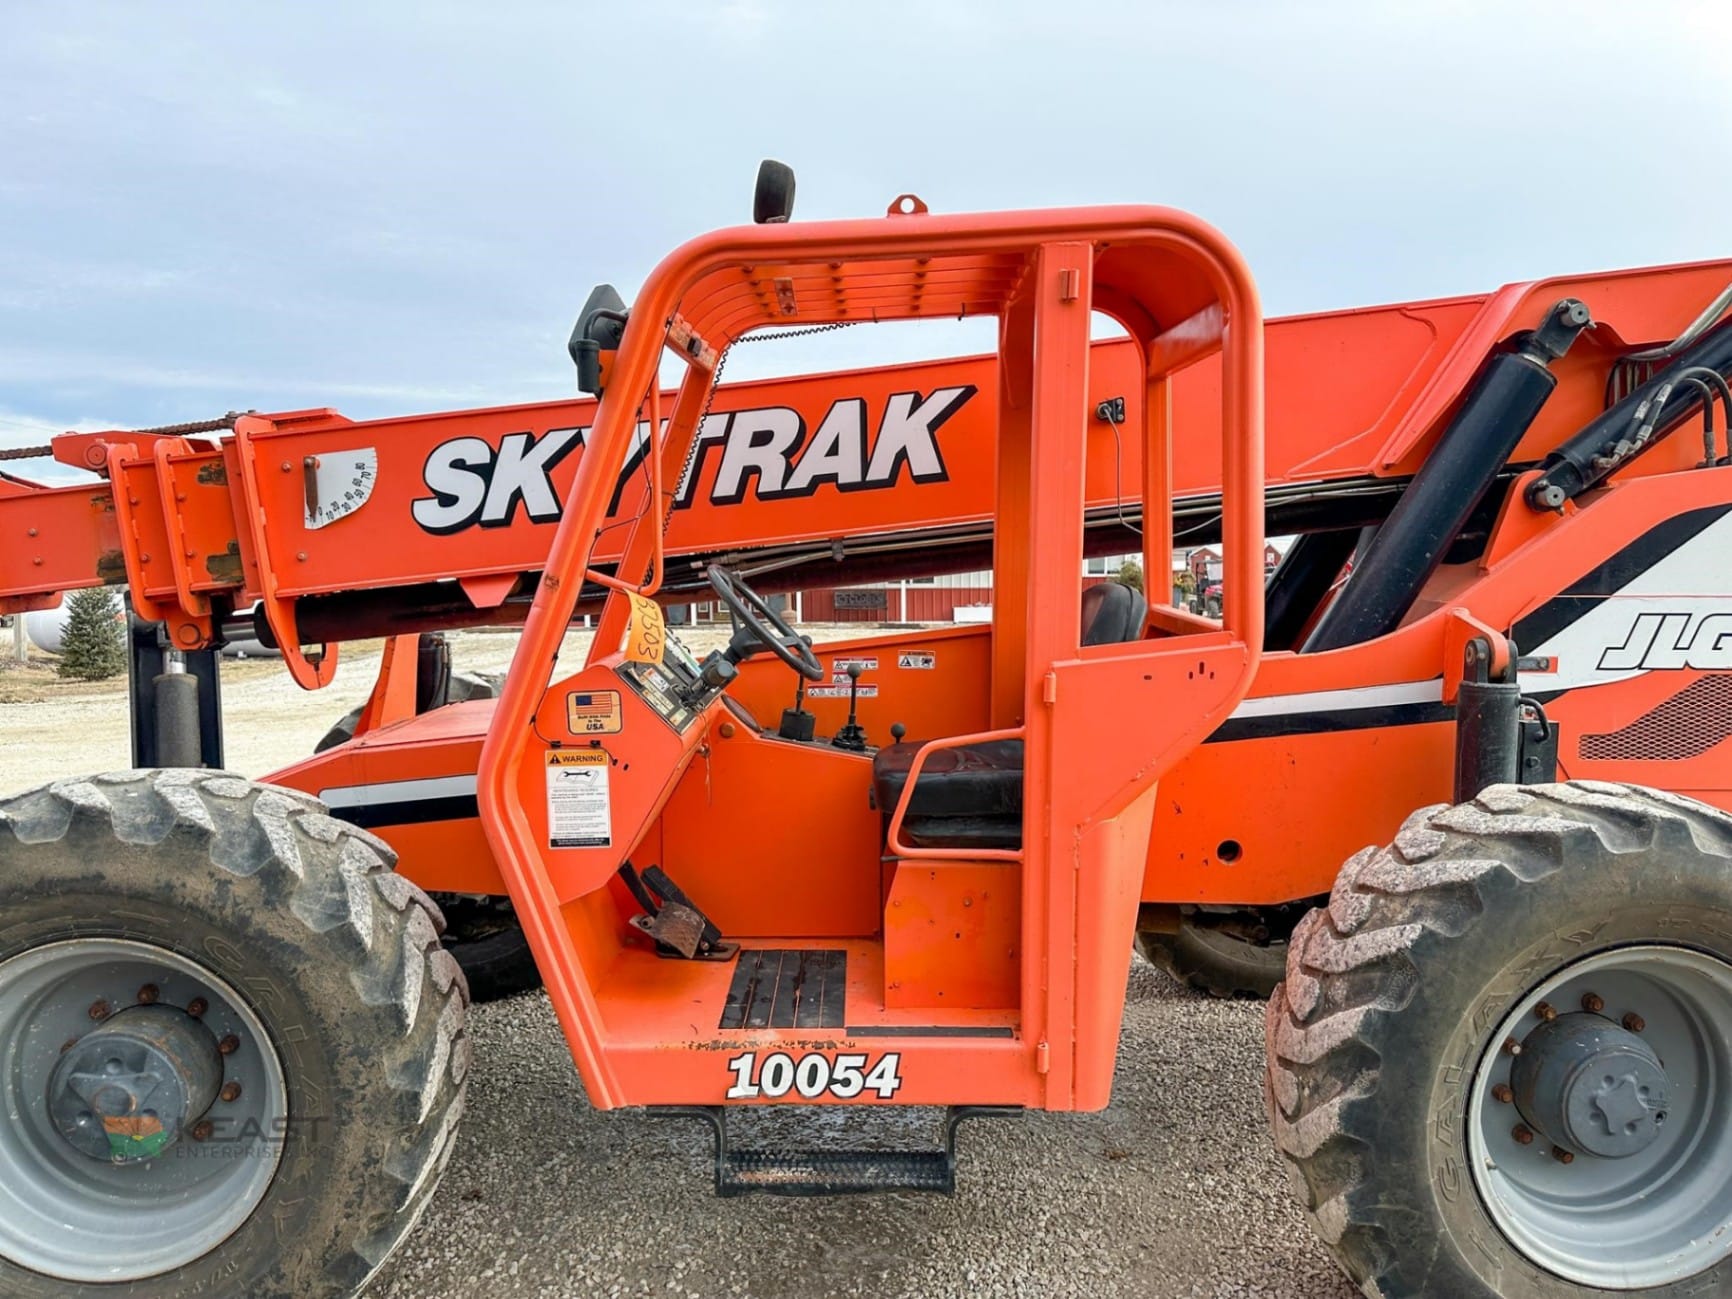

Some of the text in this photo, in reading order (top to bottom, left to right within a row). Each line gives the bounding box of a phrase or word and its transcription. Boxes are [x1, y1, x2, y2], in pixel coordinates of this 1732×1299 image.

[355, 462, 366, 470] 80
[360, 471, 372, 480] 70
[352, 477, 363, 487] 60
[344, 491, 354, 500] 40
[354, 489, 365, 499] 50
[330, 501, 340, 512] 20
[341, 502, 352, 512] 30
[325, 510, 335, 520] 10
[637, 597, 662, 660] 37503
[1596, 613, 1732, 671] JLG
[586, 723, 605, 731] USA
[562, 754, 604, 762] WARNING
[1435, 920, 1611, 1204] GALAXY
[726, 1051, 902, 1100] 10054
